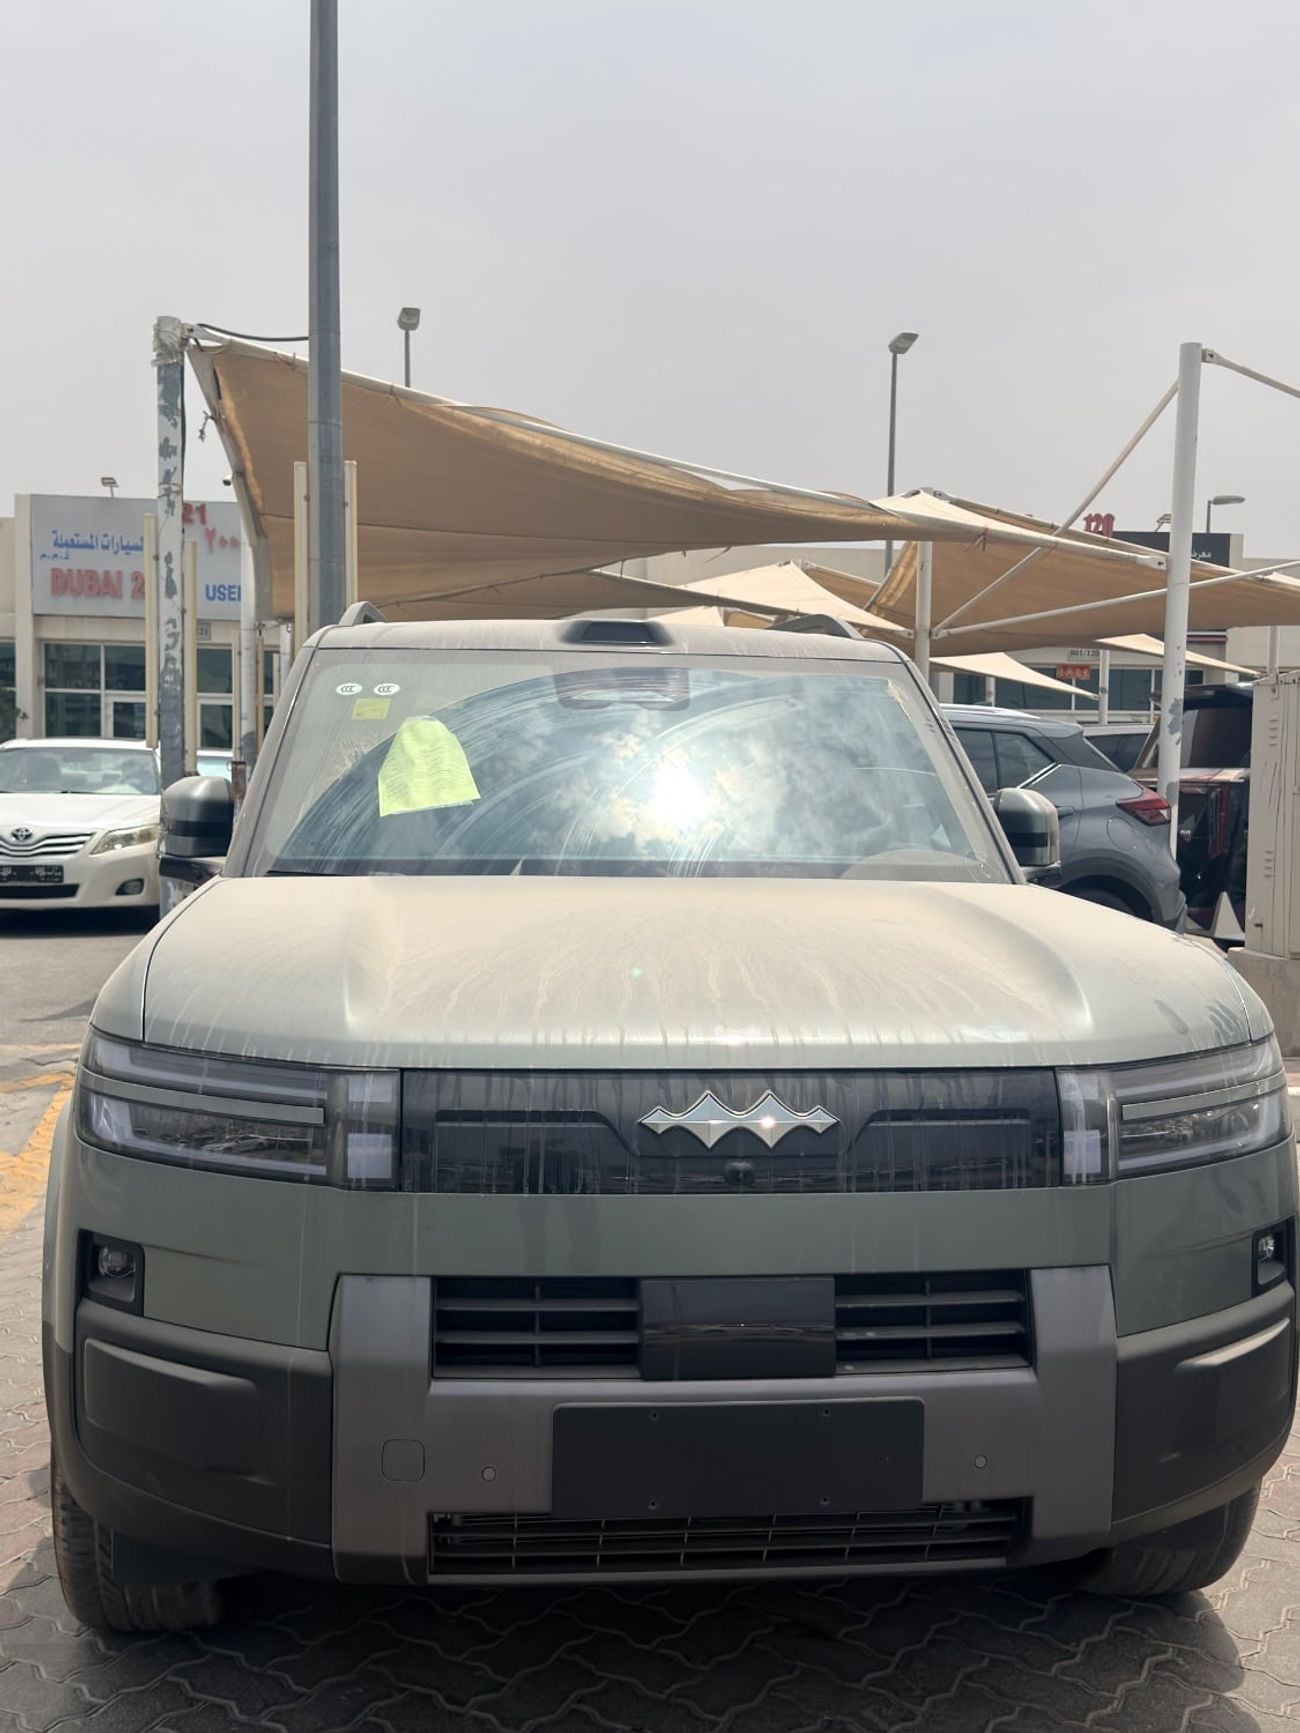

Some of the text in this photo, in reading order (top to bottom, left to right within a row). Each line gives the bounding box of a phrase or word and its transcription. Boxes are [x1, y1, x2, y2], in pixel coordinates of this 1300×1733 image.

[182, 503, 207, 526] 21
[50, 567, 123, 599] DUBAI
[205, 584, 241, 602] USE
